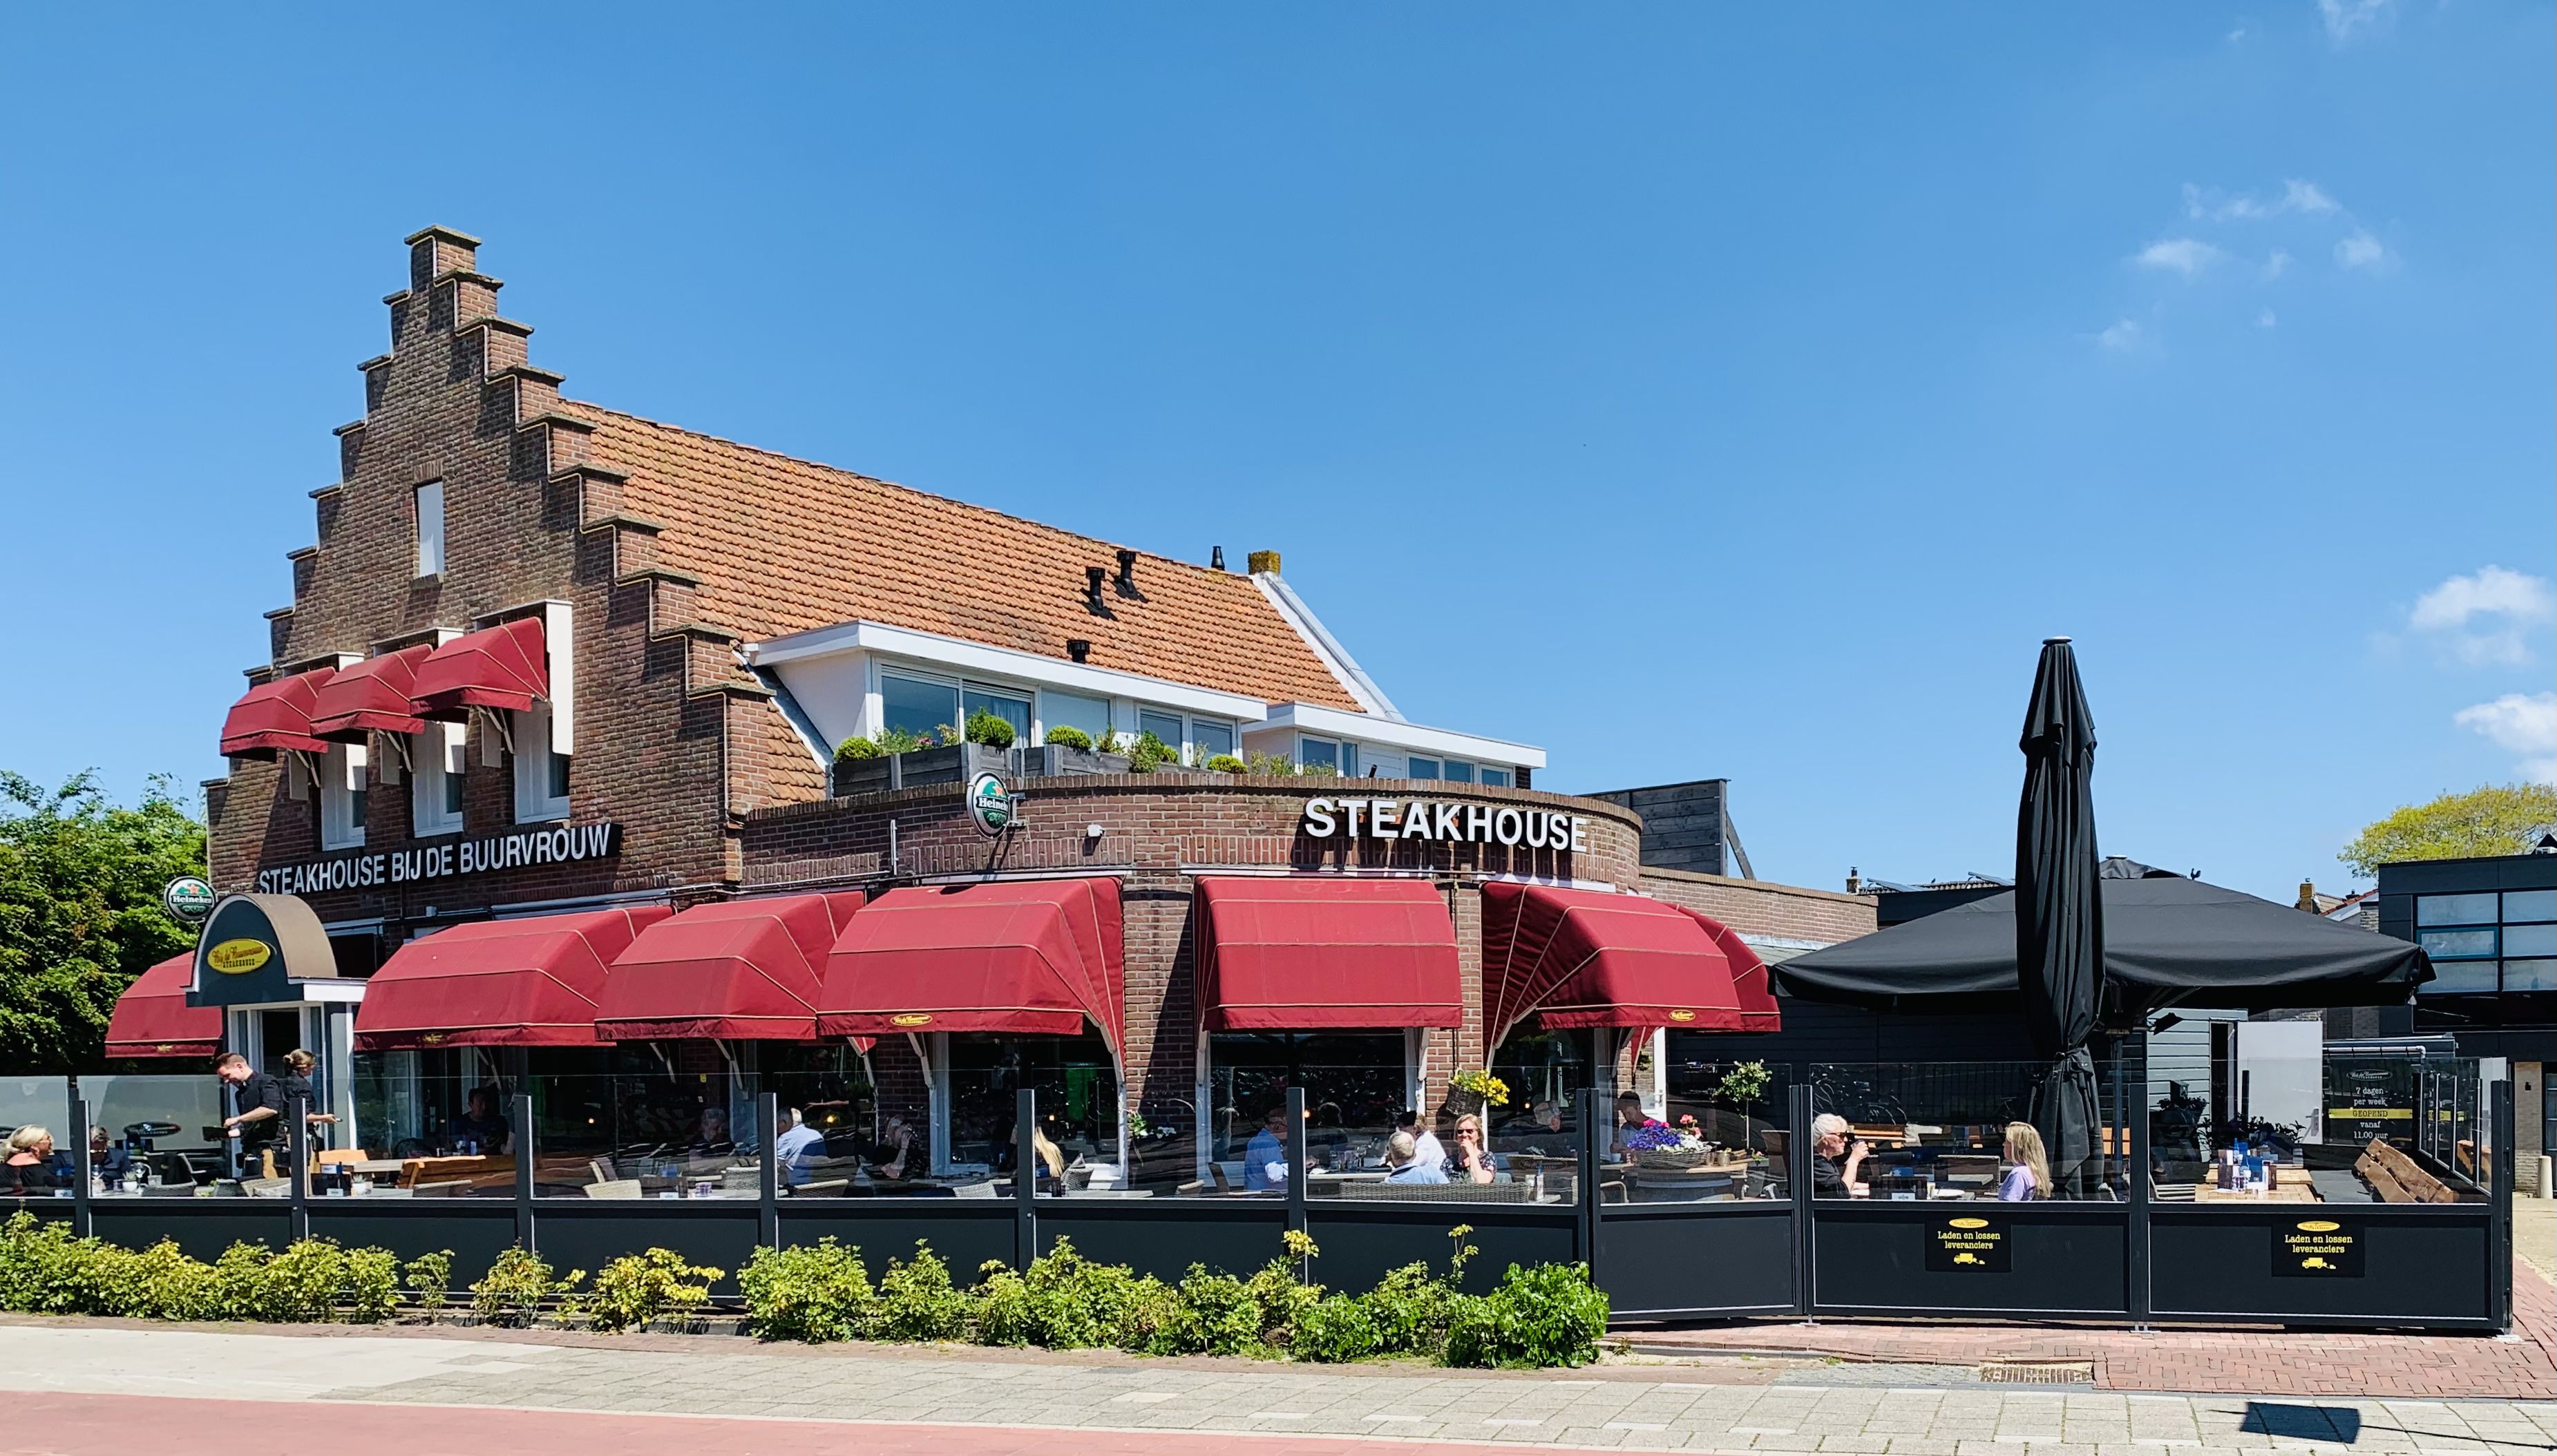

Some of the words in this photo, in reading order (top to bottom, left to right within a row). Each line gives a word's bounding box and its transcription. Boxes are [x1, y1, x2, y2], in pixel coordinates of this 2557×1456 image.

[1304, 797, 1588, 852] STEAKHOUSE
[259, 854, 385, 895] STEAKHOUSE
[391, 849, 421, 882] BIJ
[426, 844, 453, 878] DE
[460, 823, 611, 873] BUURVROUW
[2362, 1086, 2384, 1095] dagen
[2367, 1097, 2386, 1105] week
[1937, 1231, 1961, 1240] Laden
[1975, 1231, 2001, 1240] lossen
[2285, 1234, 2310, 1243] Laden
[2326, 1234, 2353, 1243] lossen
[1944, 1241, 1993, 1249] leveranciers
[2292, 1244, 2345, 1253] leveranciers
